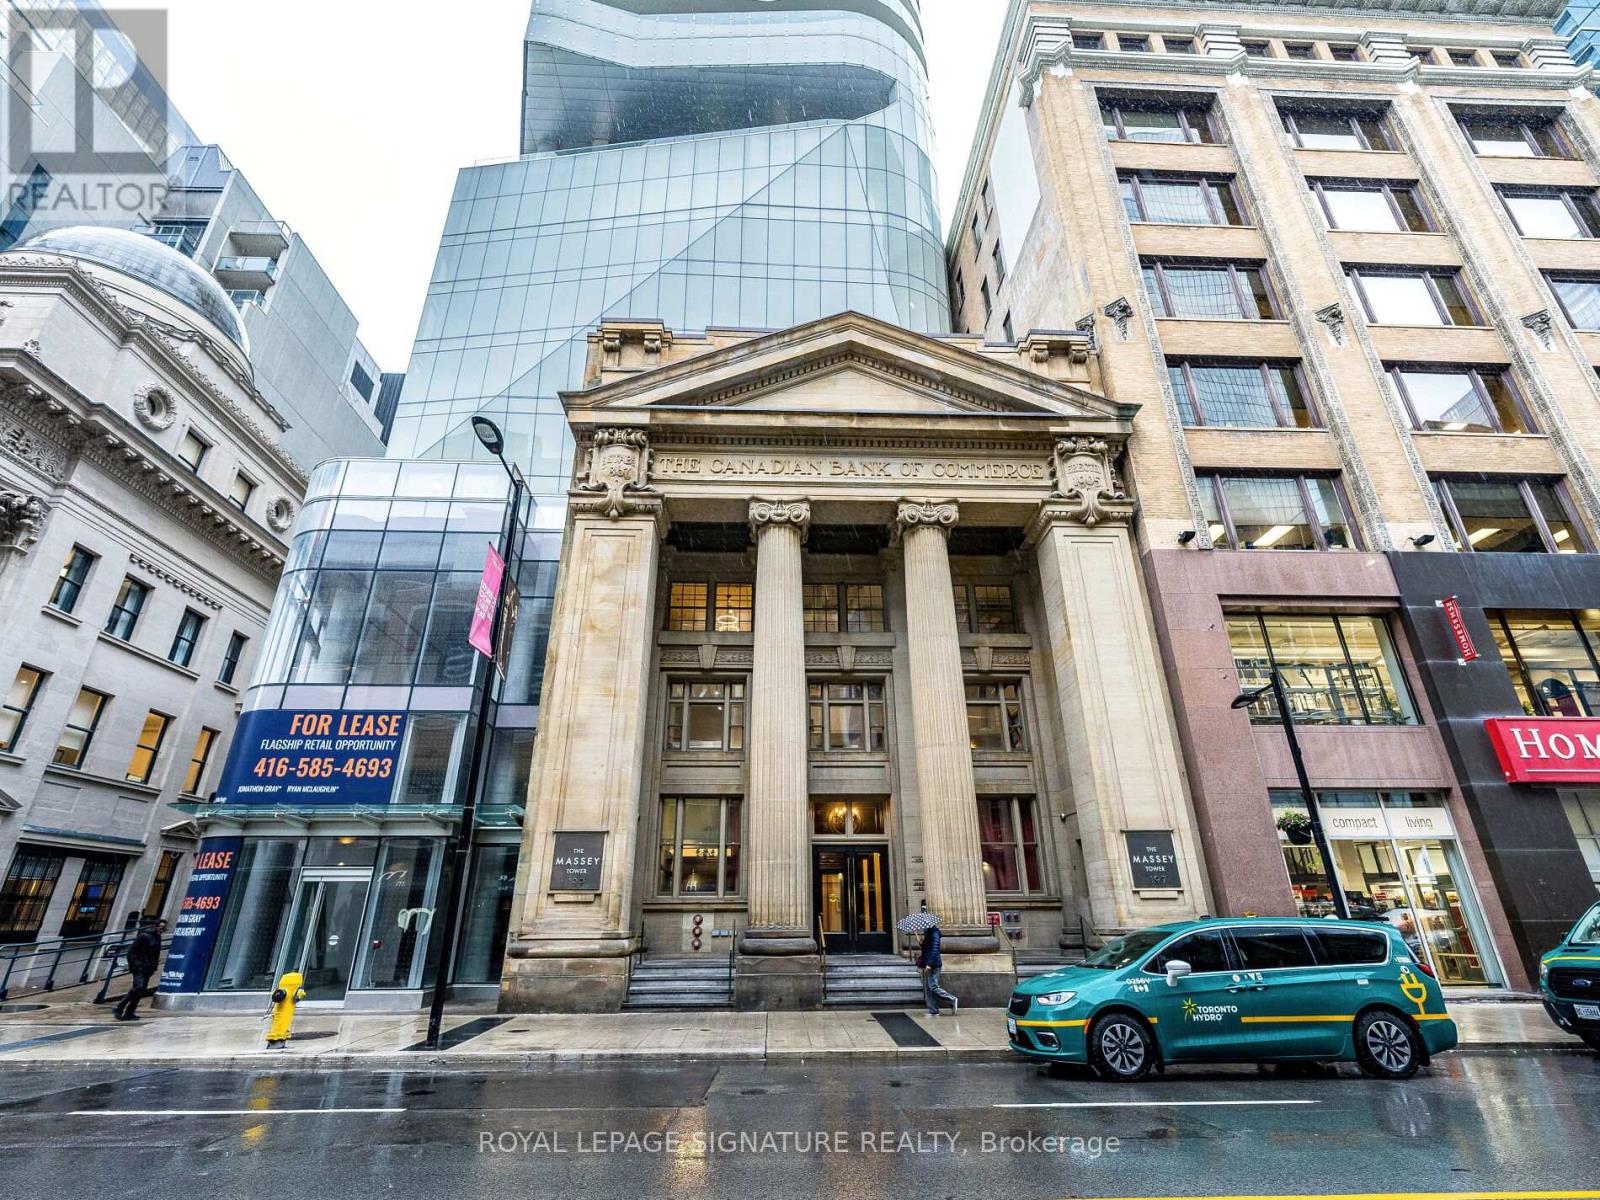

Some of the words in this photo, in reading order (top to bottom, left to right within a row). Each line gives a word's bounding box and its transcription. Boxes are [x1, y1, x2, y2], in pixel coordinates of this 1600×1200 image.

[660, 458, 700, 473] THE
[710, 459, 822, 476] CANADIAN
[829, 461, 892, 477] BANK
[901, 463, 923, 477] OF
[932, 463, 1044, 479] COMMERCE
[290, 714, 333, 736] FOR
[338, 714, 402, 736] LEASE
[260, 740, 303, 750] FLAGSHIP
[304, 740, 332, 750] RETAIL
[335, 740, 397, 751] OPPORTUNITY
[253, 757, 393, 778] 416-585-4693
[287, 785, 302, 793] RYAN
[1332, 816, 1379, 830] compact
[1404, 816, 1434, 830] living
[197, 852, 233, 869] LEASE
[555, 857, 600, 865] MASSEY
[1132, 855, 1174, 863] MASSEY
[1197, 1005, 1238, 1013] TORONTO
[1193, 1013, 1223, 1021] HYDRO
